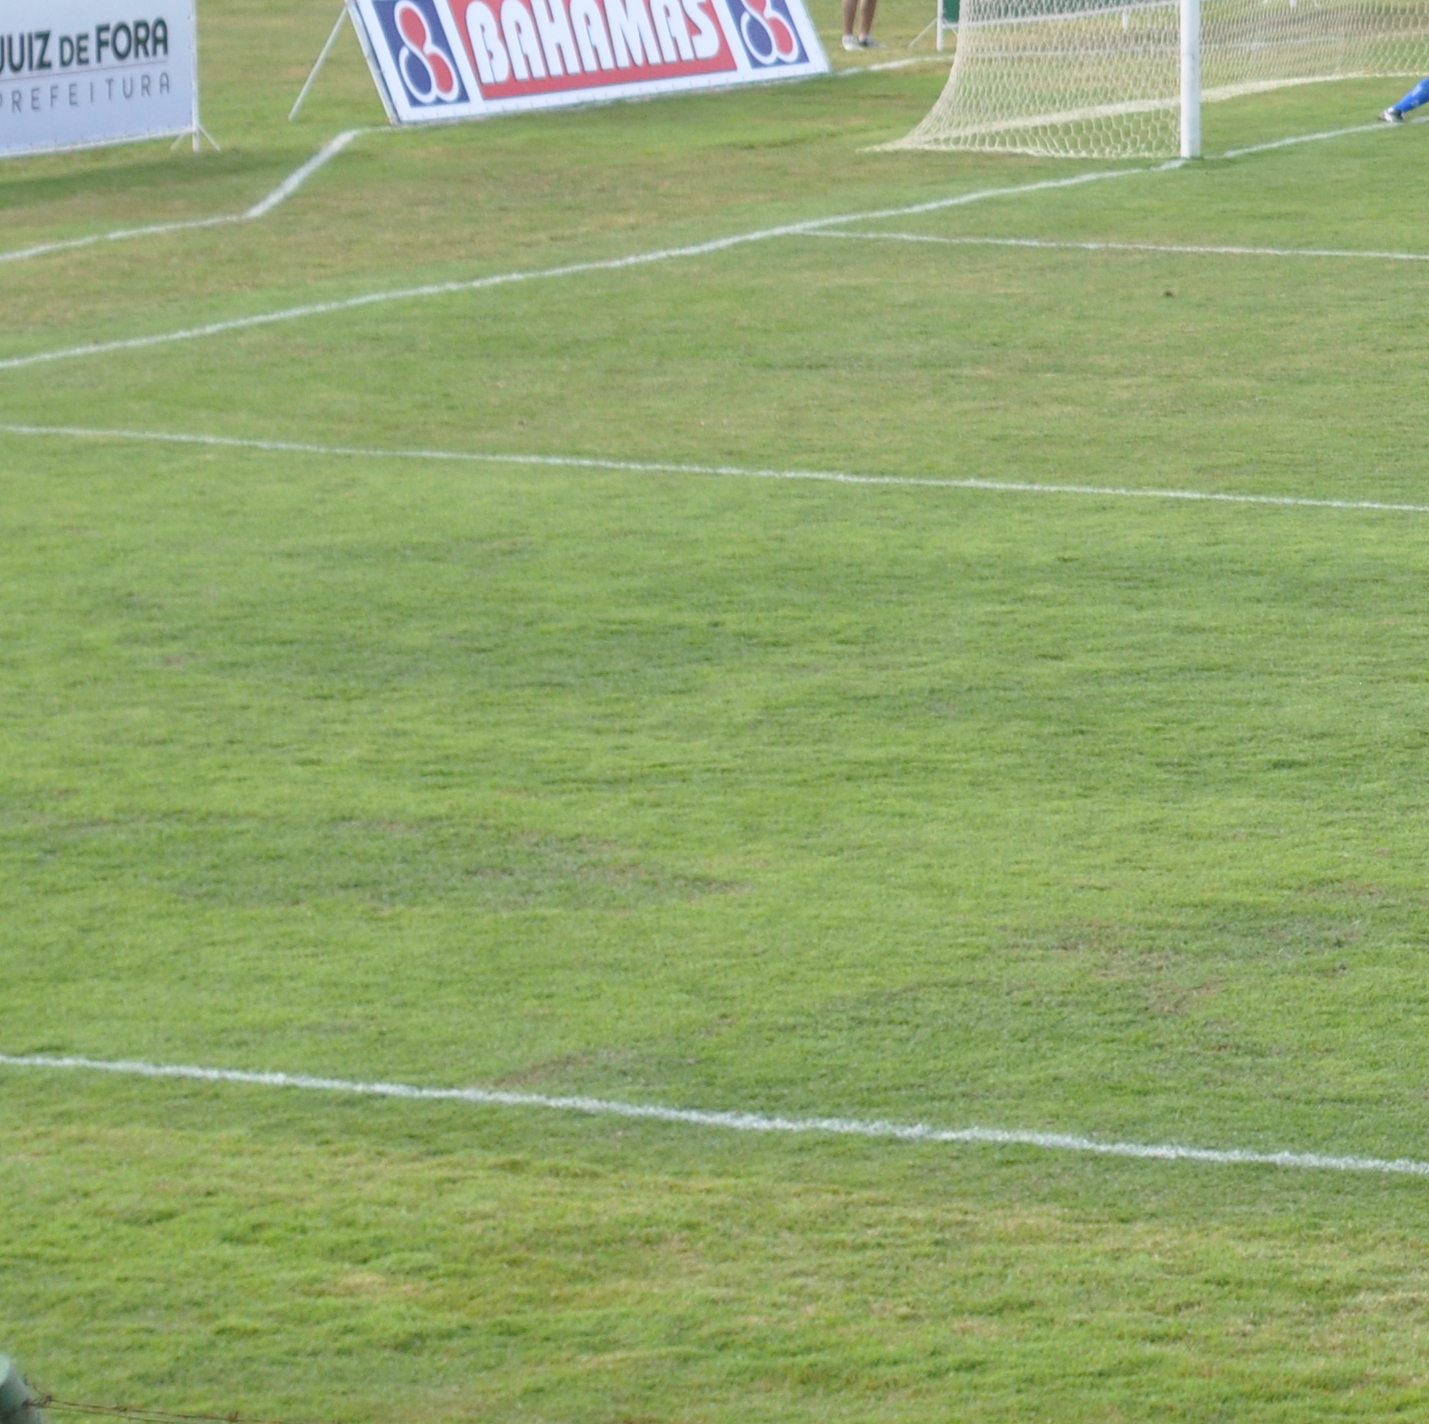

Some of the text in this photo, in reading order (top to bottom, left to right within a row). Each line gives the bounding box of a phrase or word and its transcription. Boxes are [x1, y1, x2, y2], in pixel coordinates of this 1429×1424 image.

[59, 33, 90, 68] DE
[95, 17, 169, 63] FORA
[0, 71, 170, 113] REFEITURA
